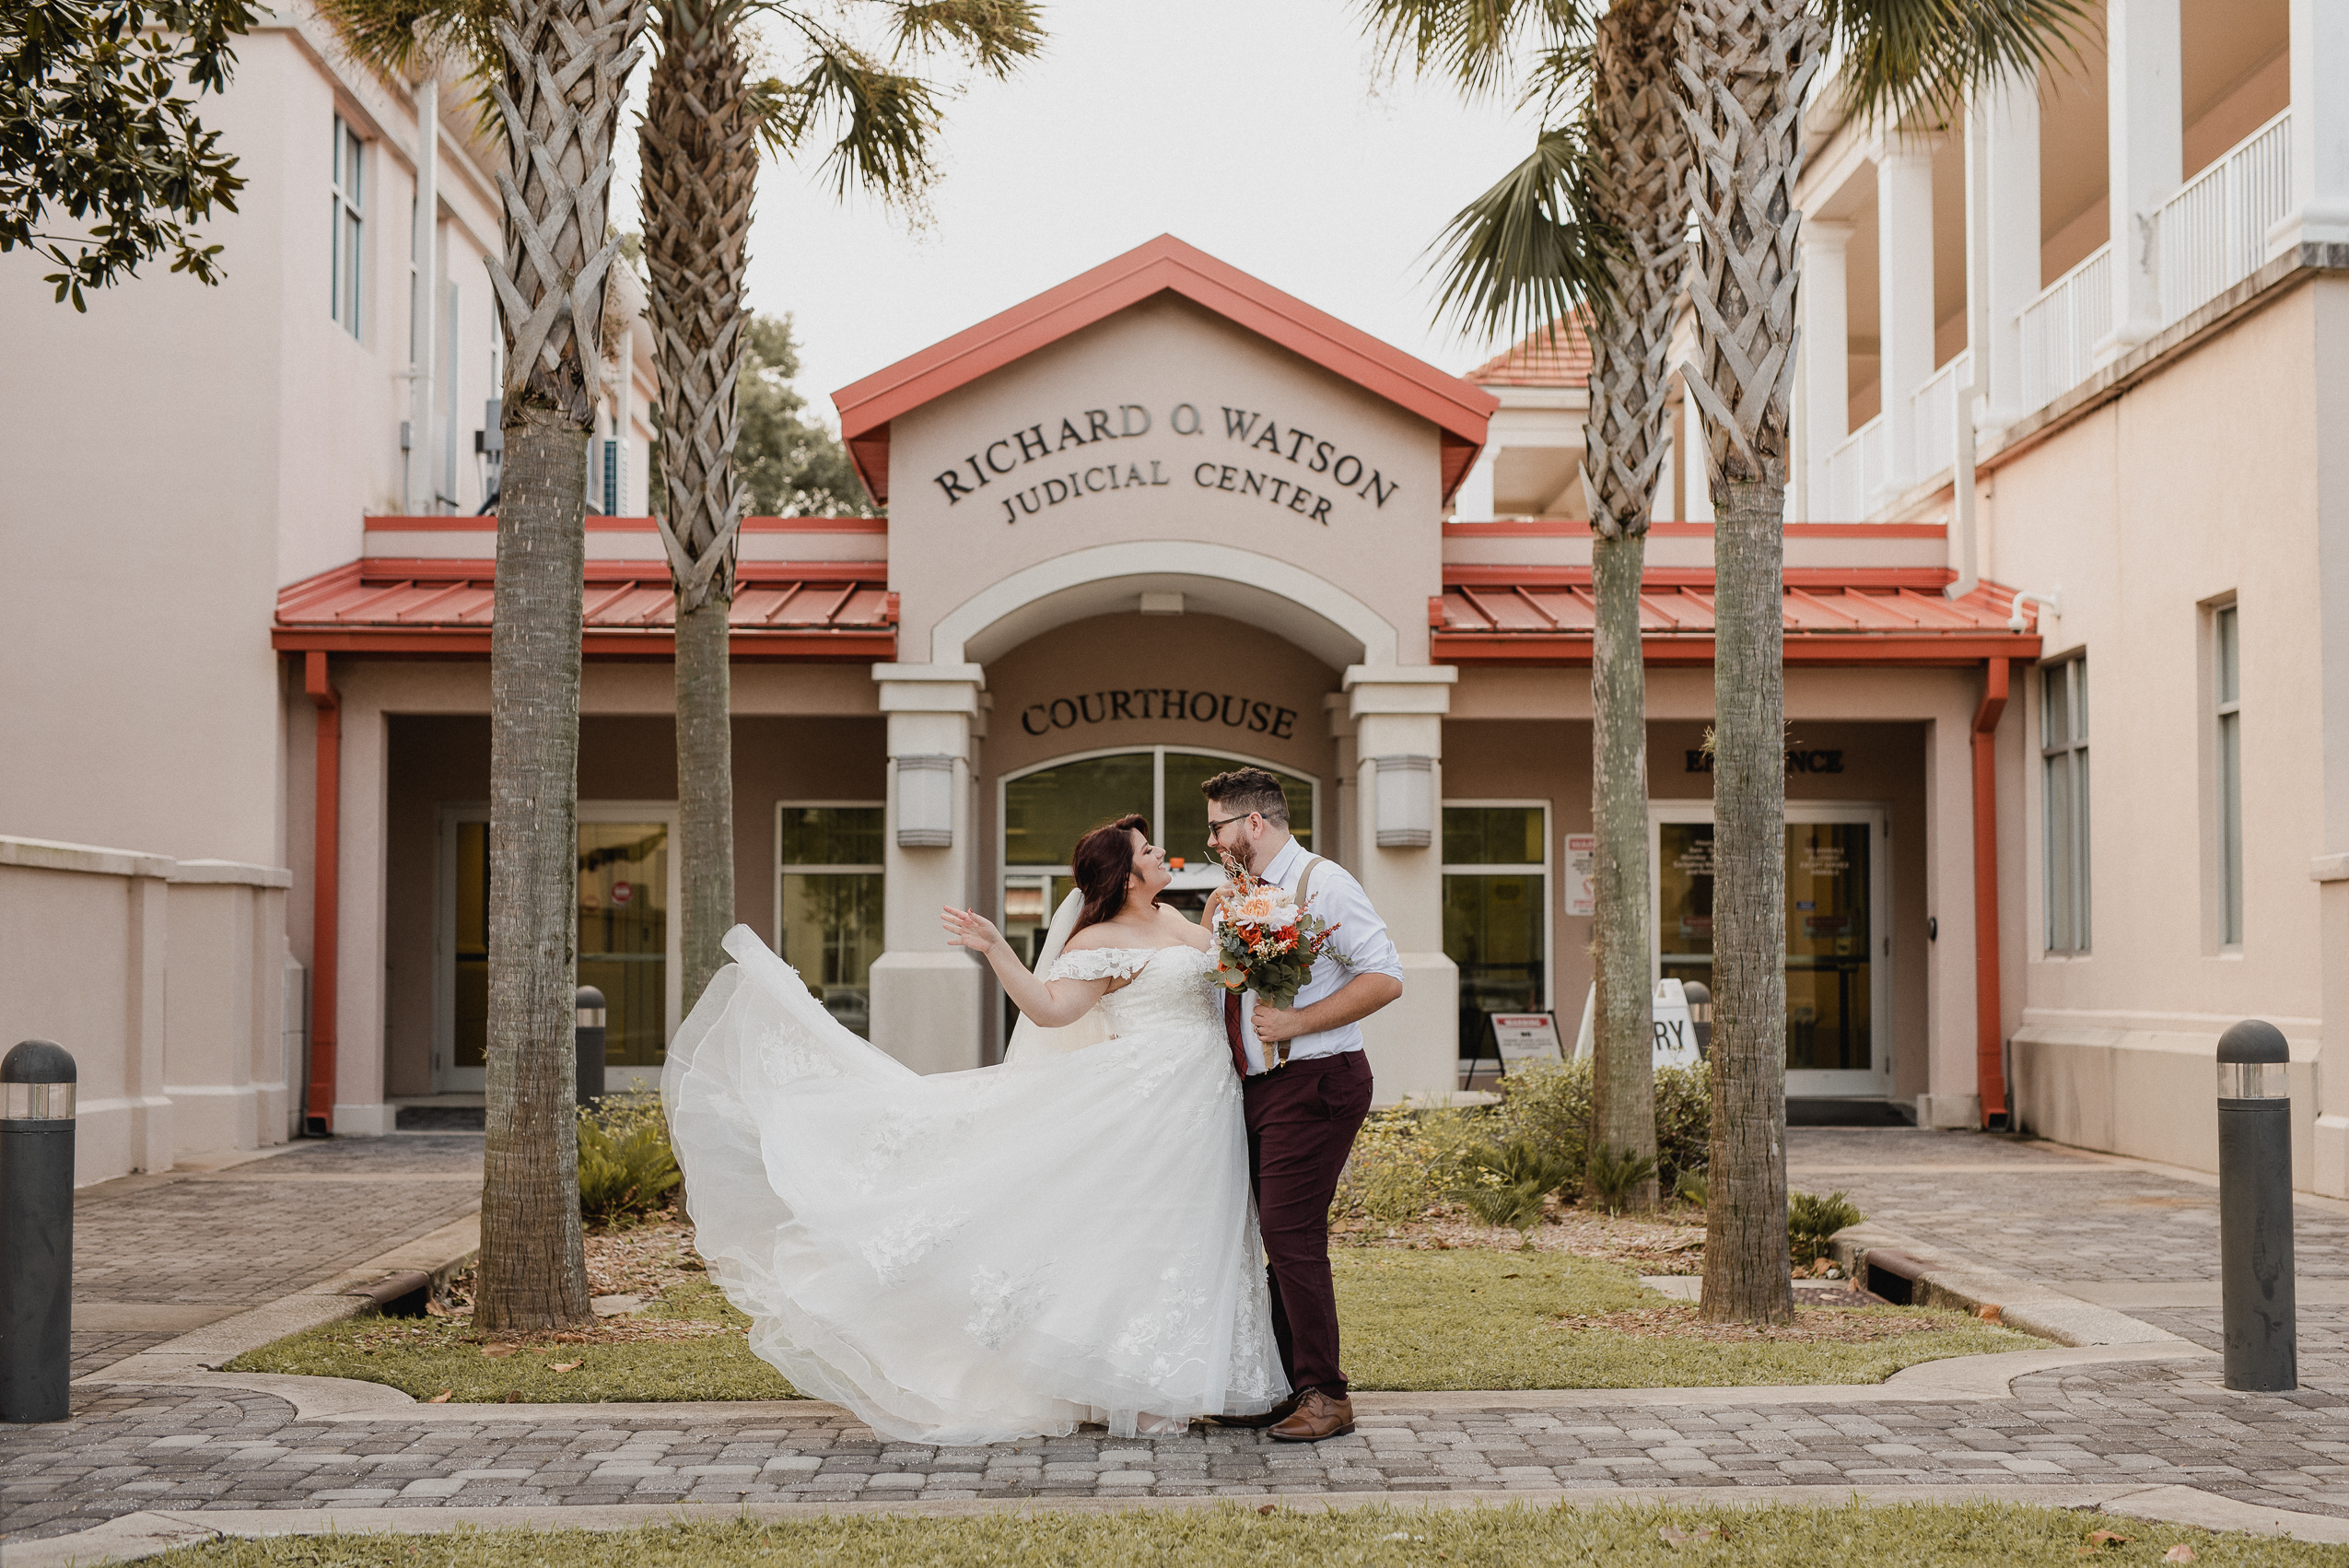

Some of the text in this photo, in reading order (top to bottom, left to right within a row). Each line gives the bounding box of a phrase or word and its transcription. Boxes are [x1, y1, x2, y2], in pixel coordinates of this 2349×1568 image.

[934, 405, 1151, 505] RICHARD
[1221, 406, 1400, 509] WATSON
[1000, 462, 1334, 525] JUDICIAL CENTER
[1021, 688, 1297, 739] COURTHOUSE
